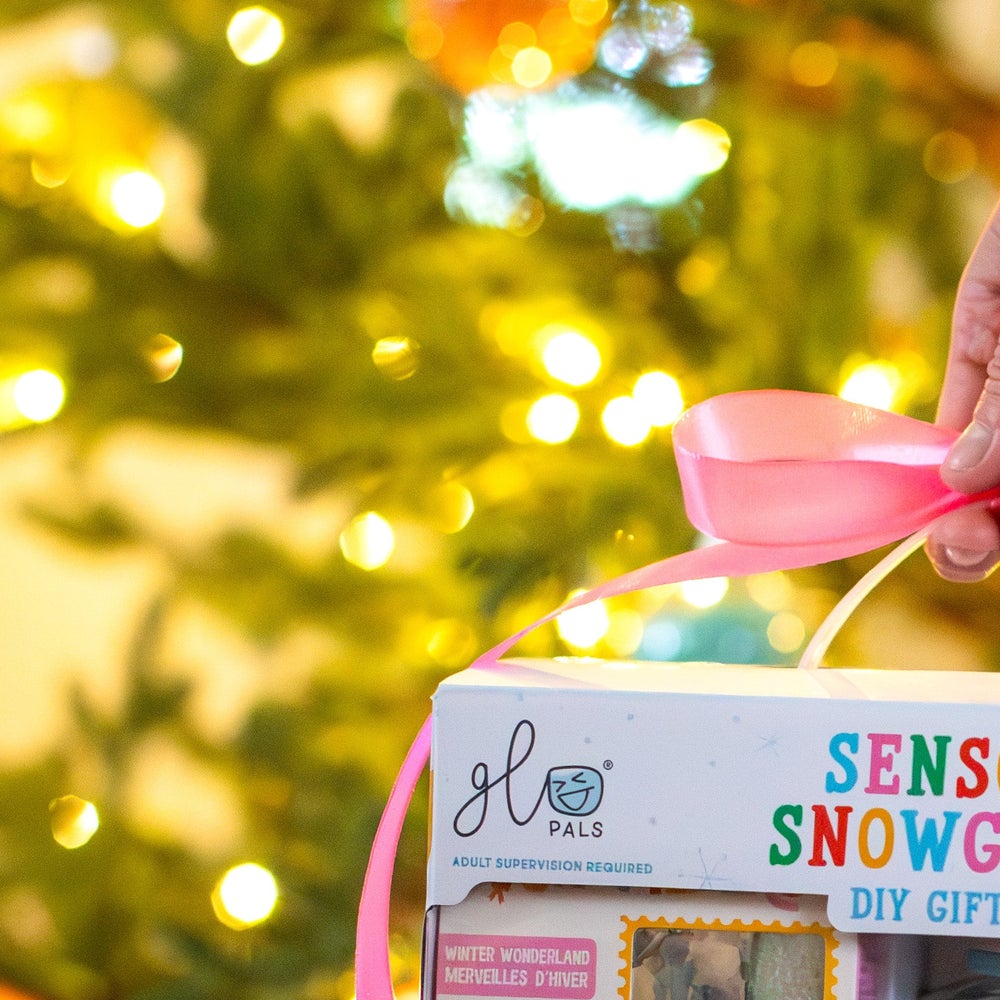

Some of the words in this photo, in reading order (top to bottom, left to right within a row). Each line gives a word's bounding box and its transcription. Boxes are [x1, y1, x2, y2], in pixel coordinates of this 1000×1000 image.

[549, 820, 603, 838] PALS
[452, 856, 492, 869] ADULT
[496, 858, 583, 872] SUPERVISION
[586, 862, 653, 874] REQUIRED
[850, 886, 910, 921] DIY
[444, 945, 496, 963] WINTER
[500, 946, 591, 966] WONDERLAND
[444, 967, 528, 986] MERVEILLES
[535, 970, 588, 989] D'HIVER
